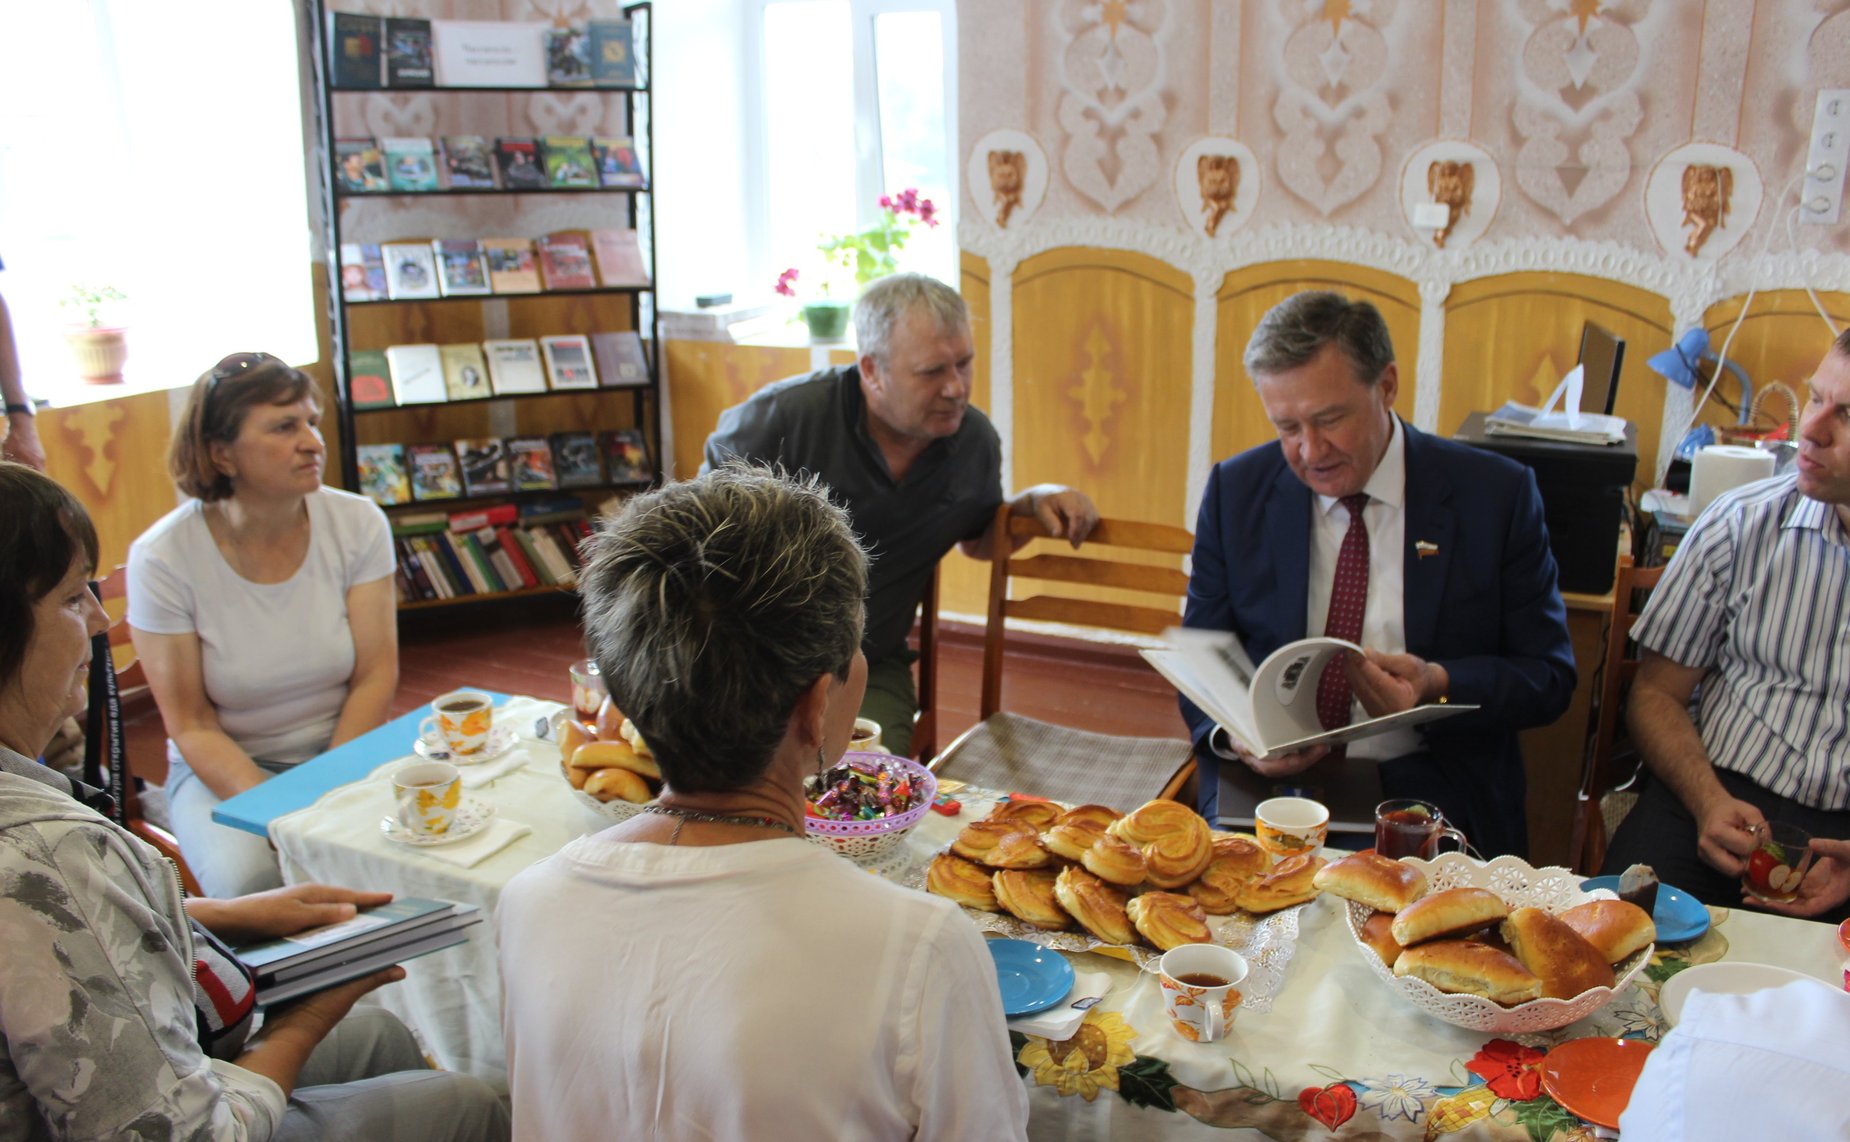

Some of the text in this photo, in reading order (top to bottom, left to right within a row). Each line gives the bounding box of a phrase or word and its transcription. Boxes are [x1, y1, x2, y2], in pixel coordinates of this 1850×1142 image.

[109, 698, 118, 718] еда
[110, 720, 121, 771] открытия
[111, 773, 122, 818] культура
